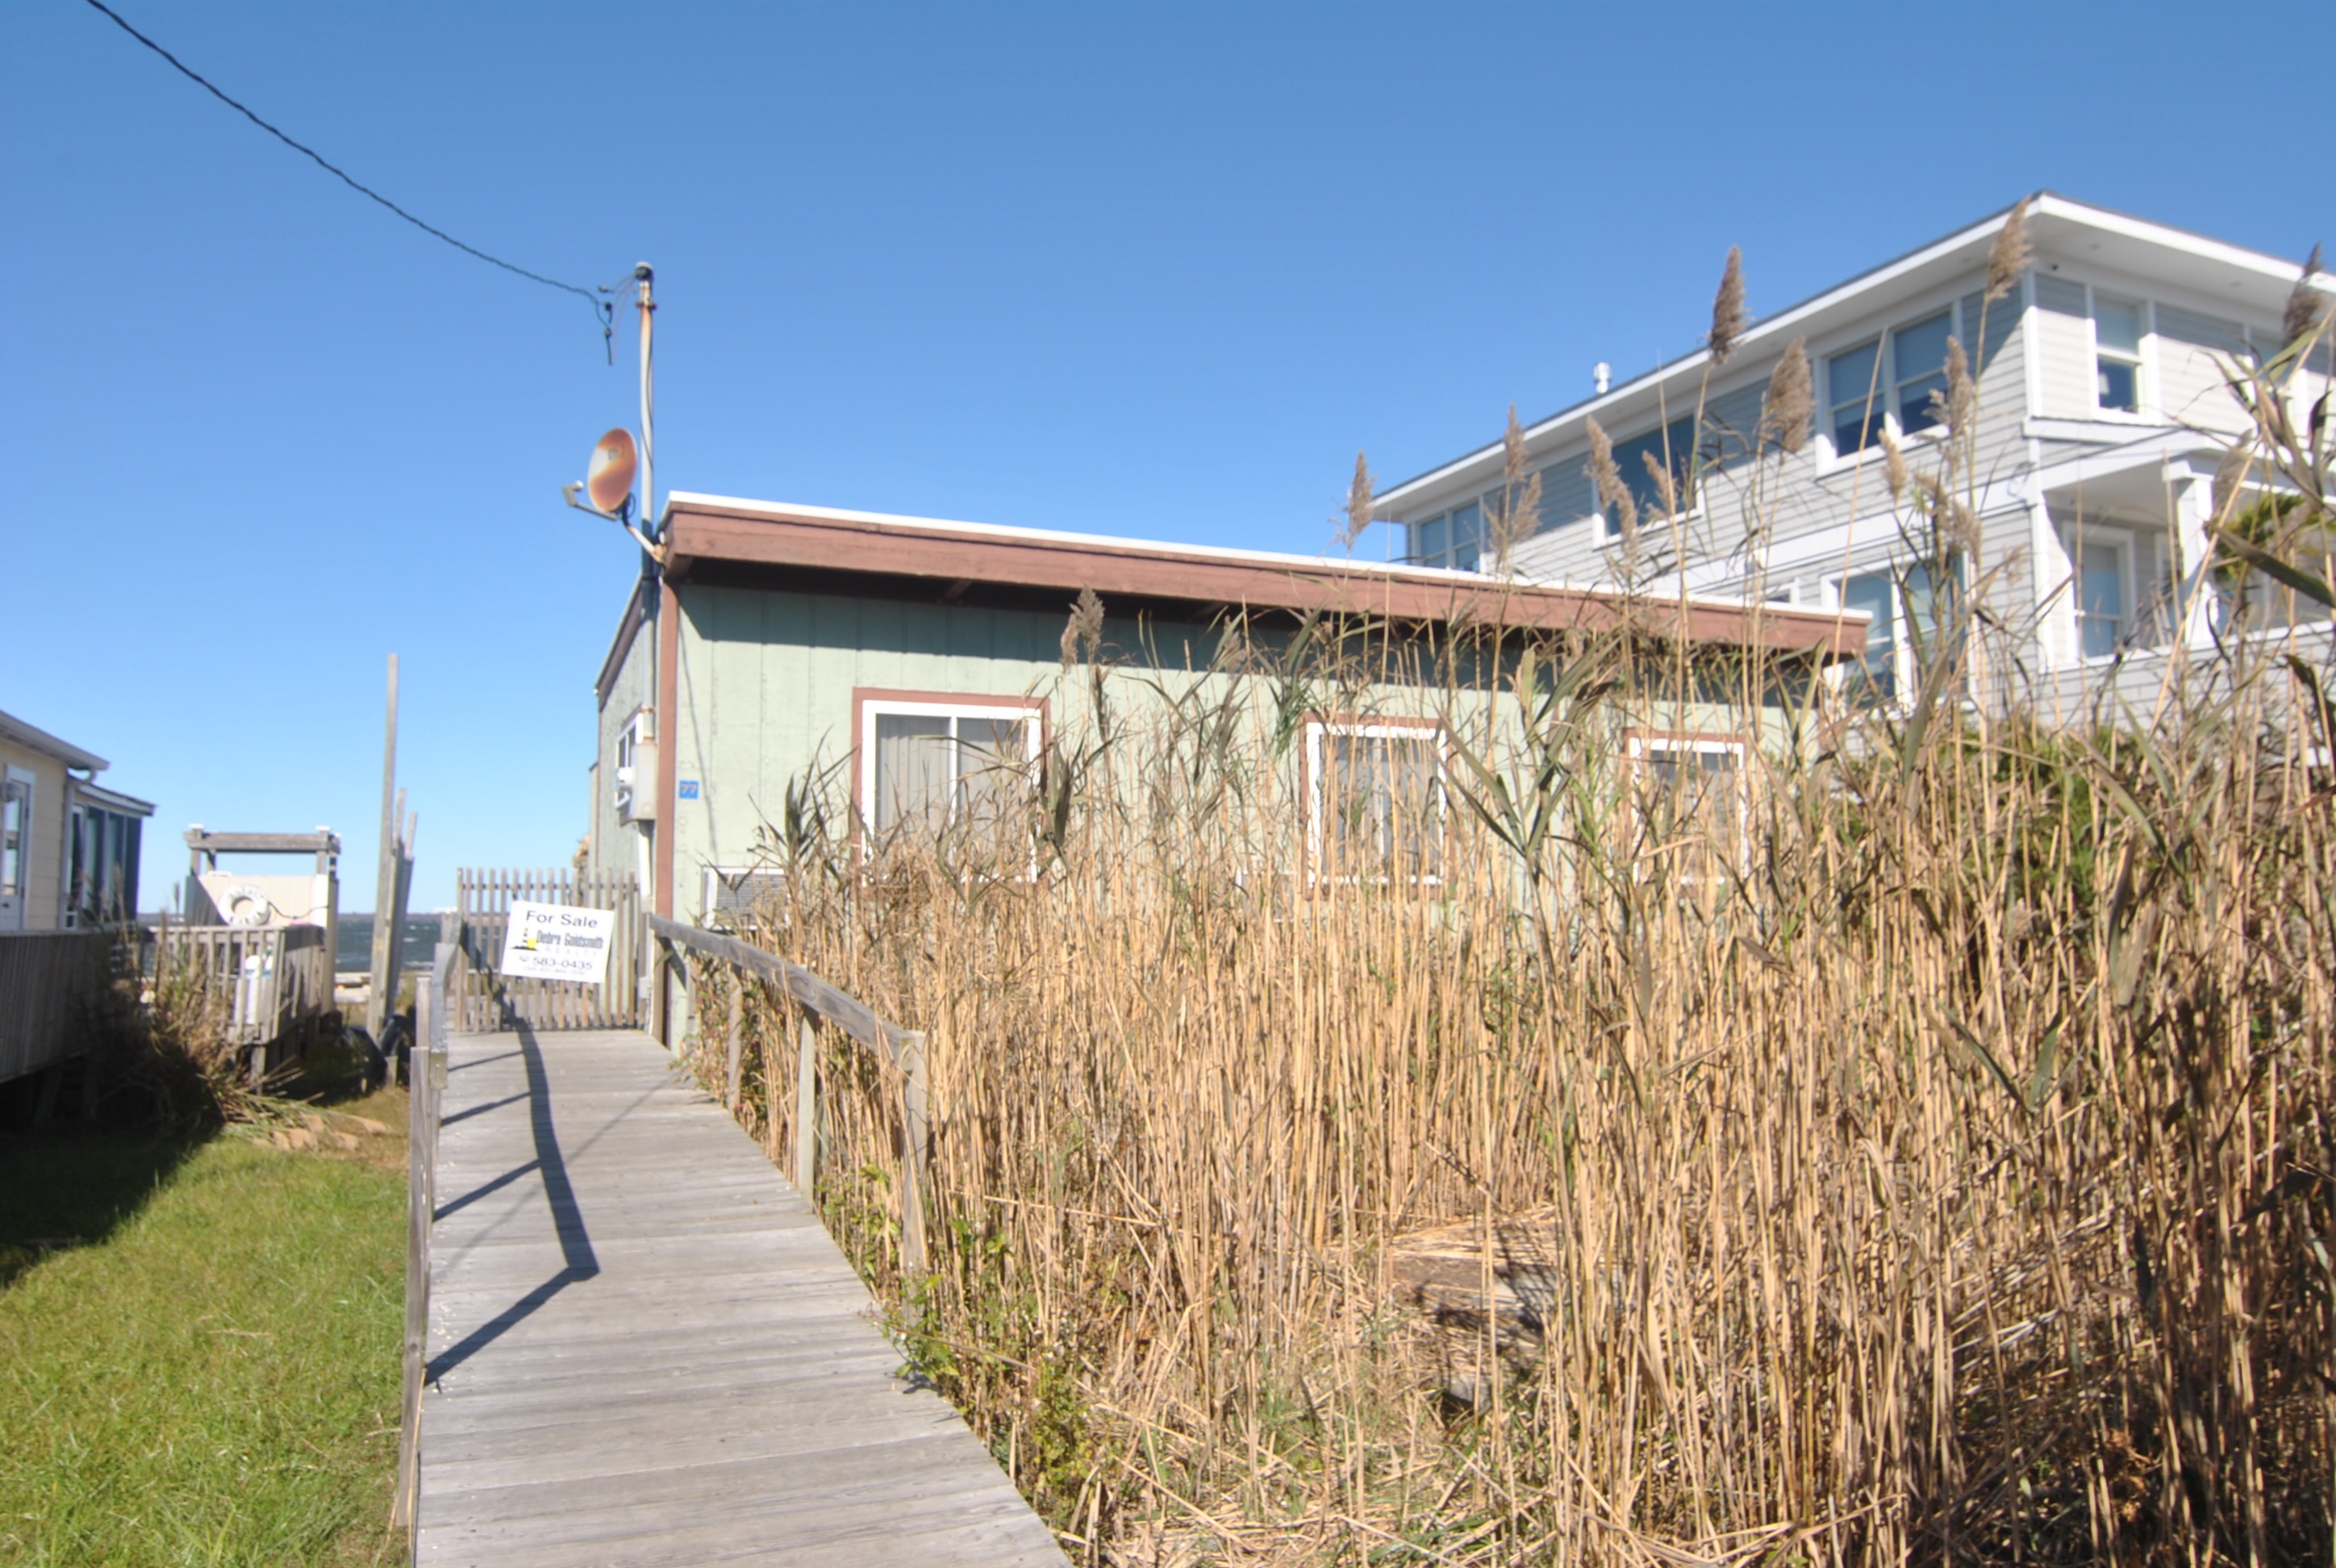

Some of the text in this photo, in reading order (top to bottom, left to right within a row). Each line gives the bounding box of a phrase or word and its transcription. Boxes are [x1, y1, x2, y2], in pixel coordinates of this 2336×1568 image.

[526, 910, 598, 928] For Sale
[564, 932, 604, 949] Goldsmith
